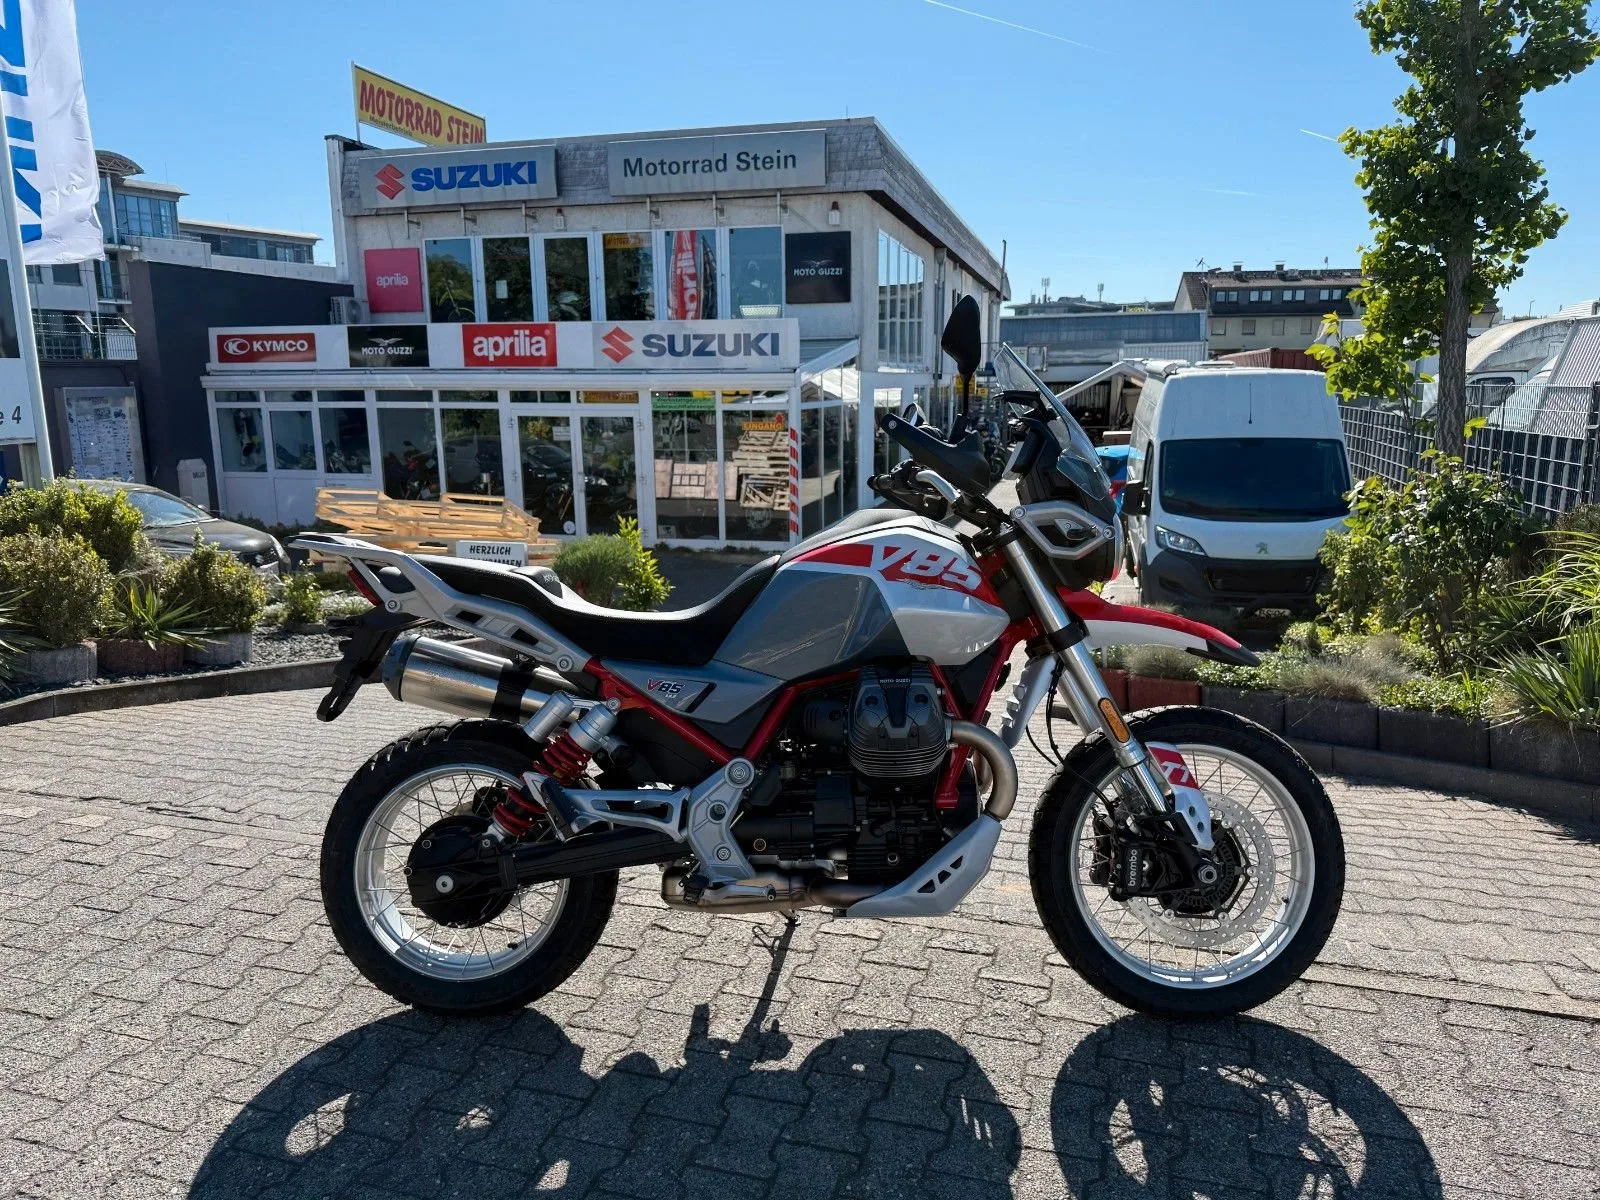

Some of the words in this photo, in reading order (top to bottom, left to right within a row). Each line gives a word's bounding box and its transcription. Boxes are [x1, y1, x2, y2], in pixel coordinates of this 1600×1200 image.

[359, 79, 442, 138] MOTORRAD
[446, 115, 483, 145] STEIN
[623, 153, 728, 178] Motorrad
[736, 149, 797, 172] Stein
[411, 160, 538, 192] SUZUKI
[376, 272, 409, 289] aprilia
[793, 267, 816, 277] MOTO
[818, 266, 843, 276] GUZZI
[253, 339, 309, 352] KYMCO
[361, 346, 385, 356] MOTO
[387, 346, 413, 355] GUZZI
[473, 329, 547, 362] aprilia
[641, 332, 780, 357] SUZUKI
[11, 405, 22, 424] 4
[469, 545, 511, 556] HERZLICH
[869, 544, 983, 591] V85
[647, 678, 686, 694] V85
[1128, 848, 1138, 887] brembo
